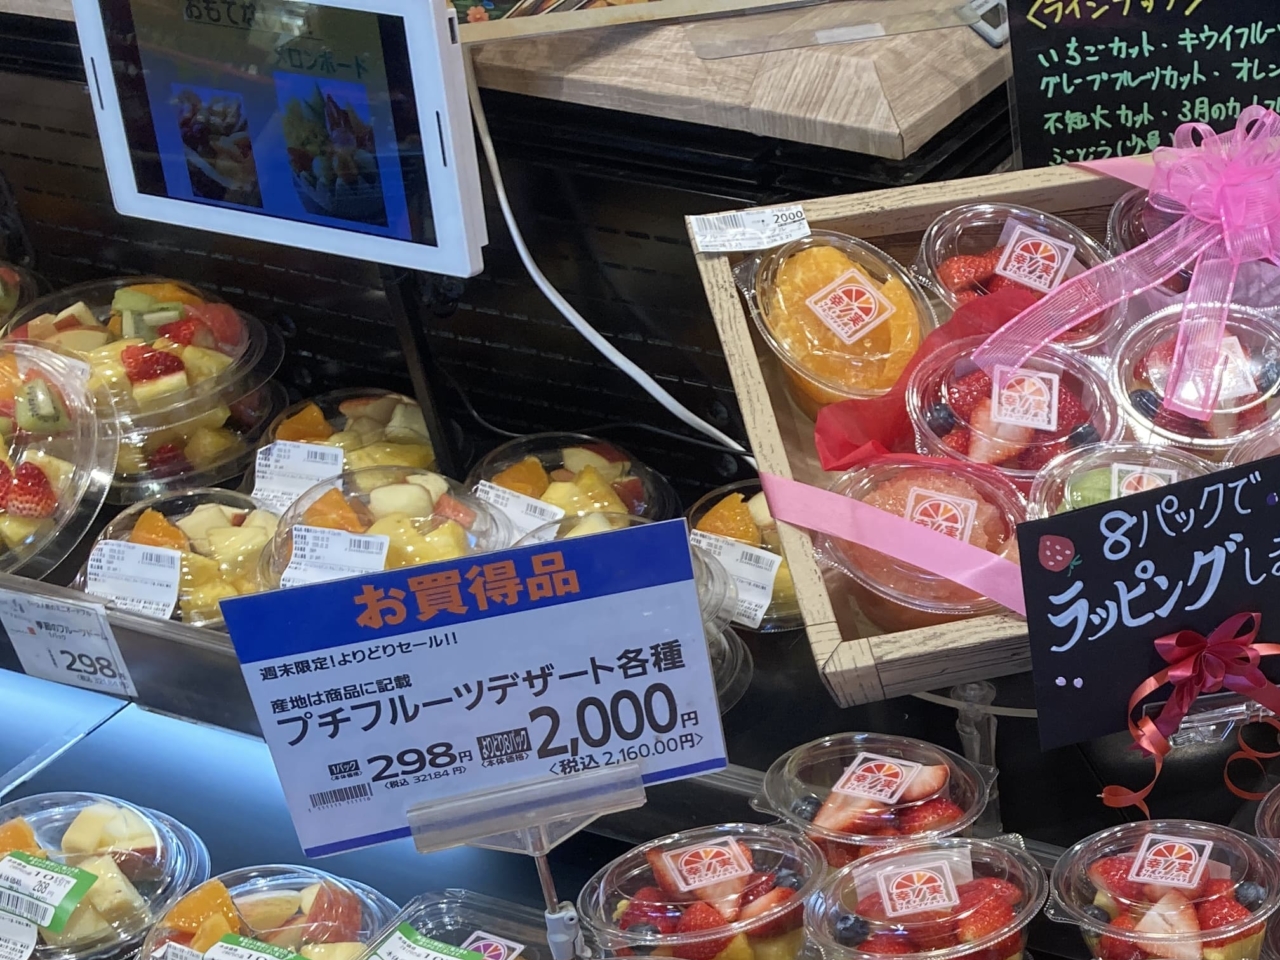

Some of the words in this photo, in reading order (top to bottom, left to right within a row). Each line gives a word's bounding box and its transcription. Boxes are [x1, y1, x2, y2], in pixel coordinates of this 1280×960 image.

[773, 210, 803, 224] 2000
[1100, 470, 1261, 561] 8パックで
[354, 551, 580, 630] お買得品
[271, 674, 412, 714] 産地は商品に記載
[277, 639, 685, 746] プチフルーツデザート各種
